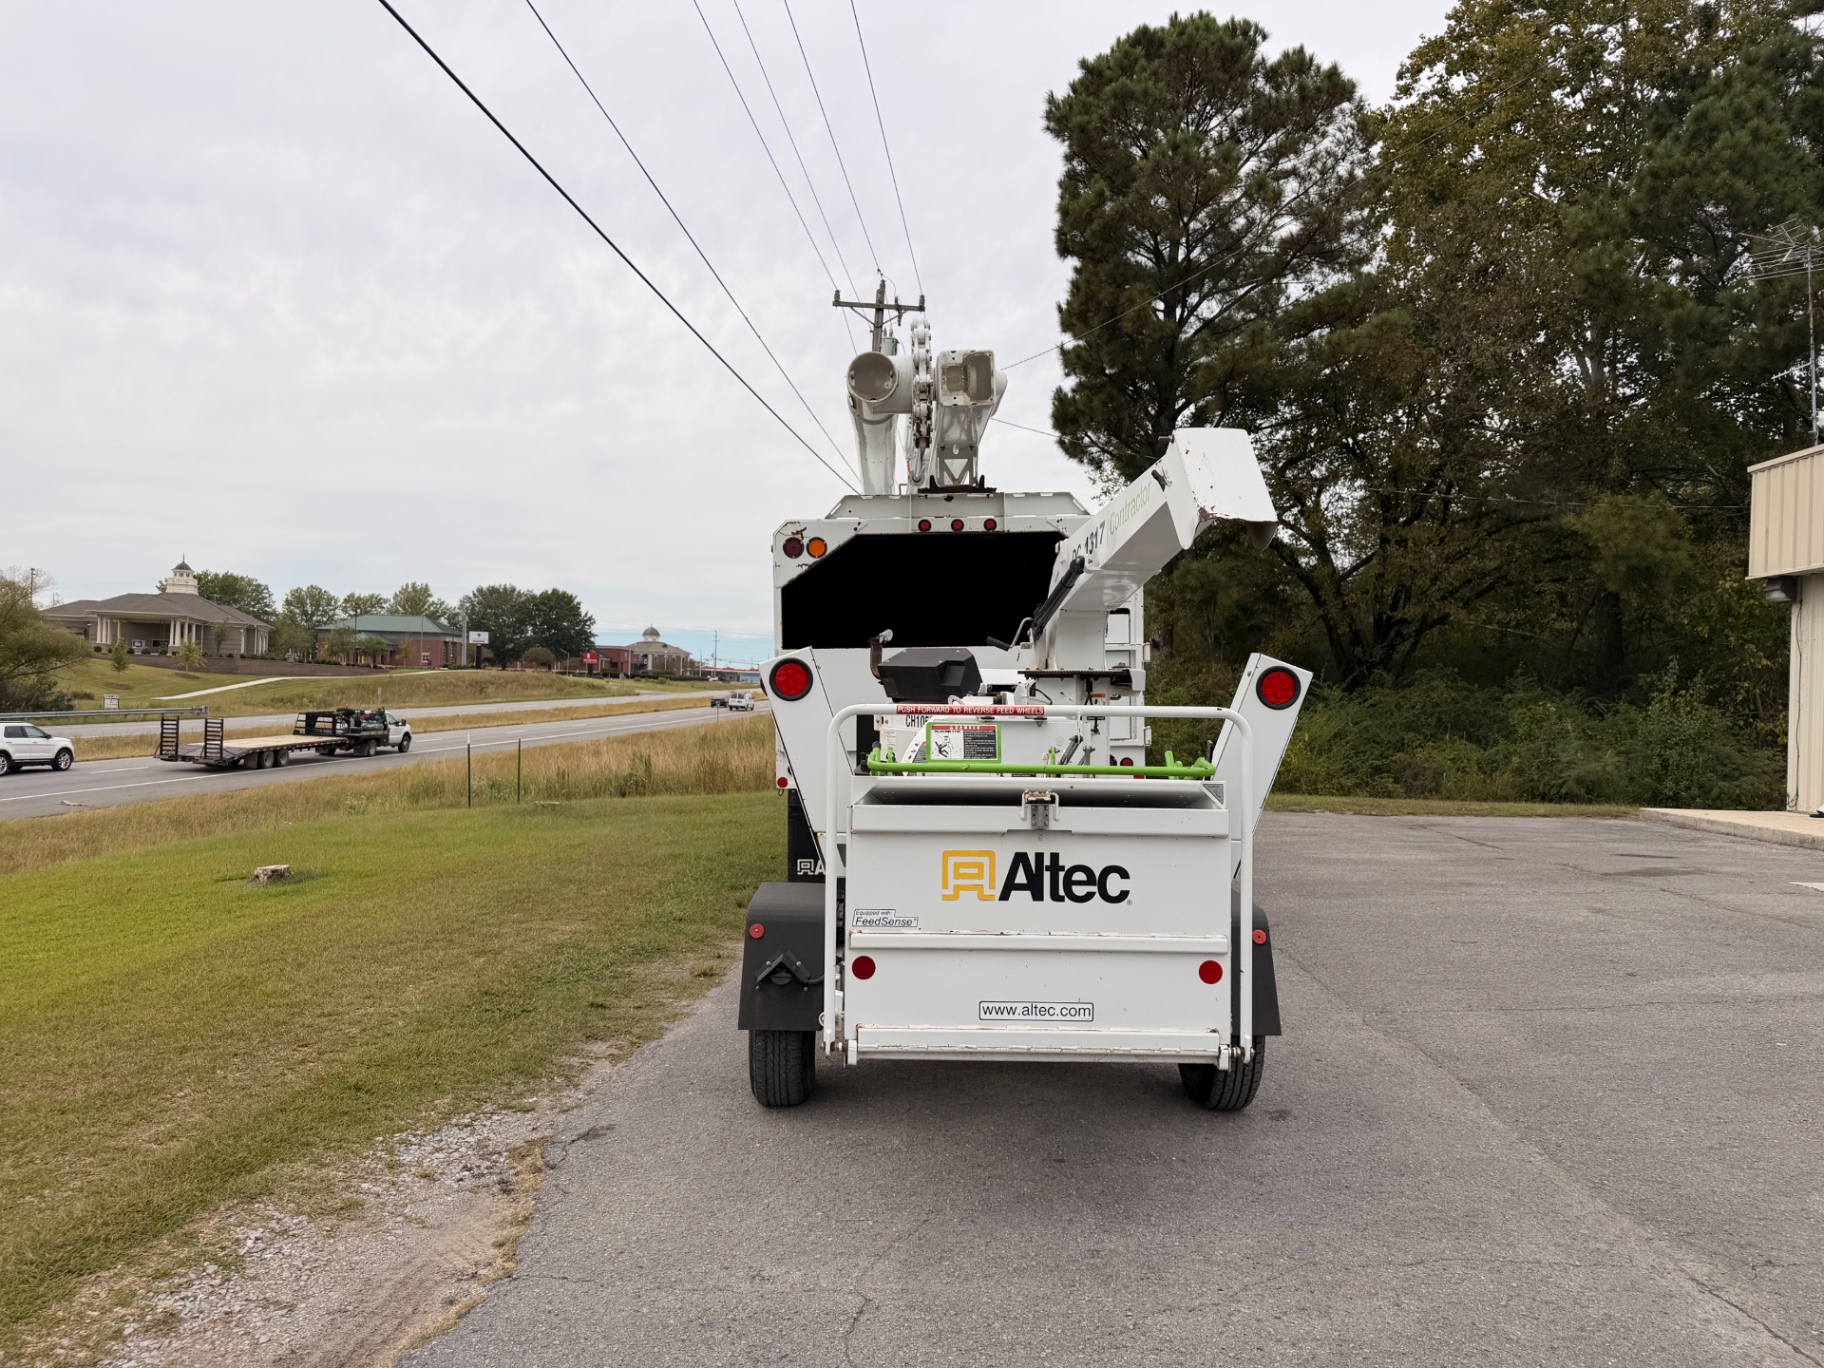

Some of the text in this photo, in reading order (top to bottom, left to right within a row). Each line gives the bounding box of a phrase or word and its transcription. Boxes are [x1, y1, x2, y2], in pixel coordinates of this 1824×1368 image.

[1085, 519, 1106, 555] 1317
[1109, 482, 1151, 535] Contractor
[897, 705, 1044, 714] PUSH FORWARD TO REVERSE FEED WHEELS
[998, 852, 1130, 904] Altec
[982, 1003, 1091, 1017] www.altec.com
